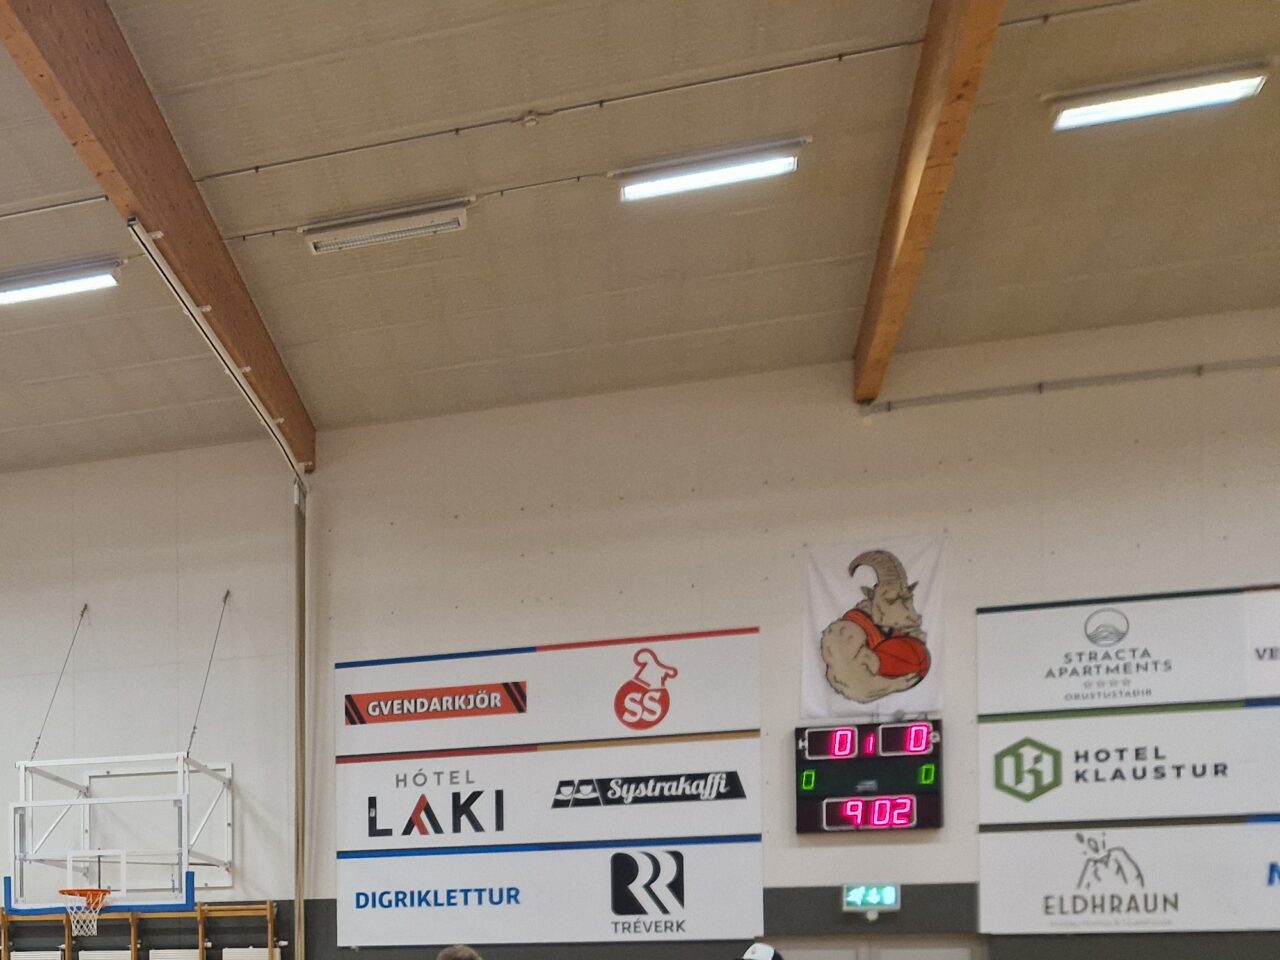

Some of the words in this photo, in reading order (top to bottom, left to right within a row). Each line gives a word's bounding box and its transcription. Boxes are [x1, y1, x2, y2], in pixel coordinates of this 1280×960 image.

[1063, 648, 1152, 664] STRACTA
[1044, 659, 1173, 679] APARTMENTS
[367, 690, 502, 717] GVENDARKJÖR
[622, 691, 662, 723] SS
[1074, 746, 1166, 763] HOTEL
[395, 768, 475, 788] HÓTEL
[1074, 763, 1228, 783] KLAUSTUR
[607, 773, 730, 804] Systrakaffi
[368, 789, 504, 837] LAKI
[355, 887, 521, 909] DIGRIKLETTUR
[1043, 892, 1179, 915] ELDHRAUN
[611, 918, 686, 934] TRÉVERK
